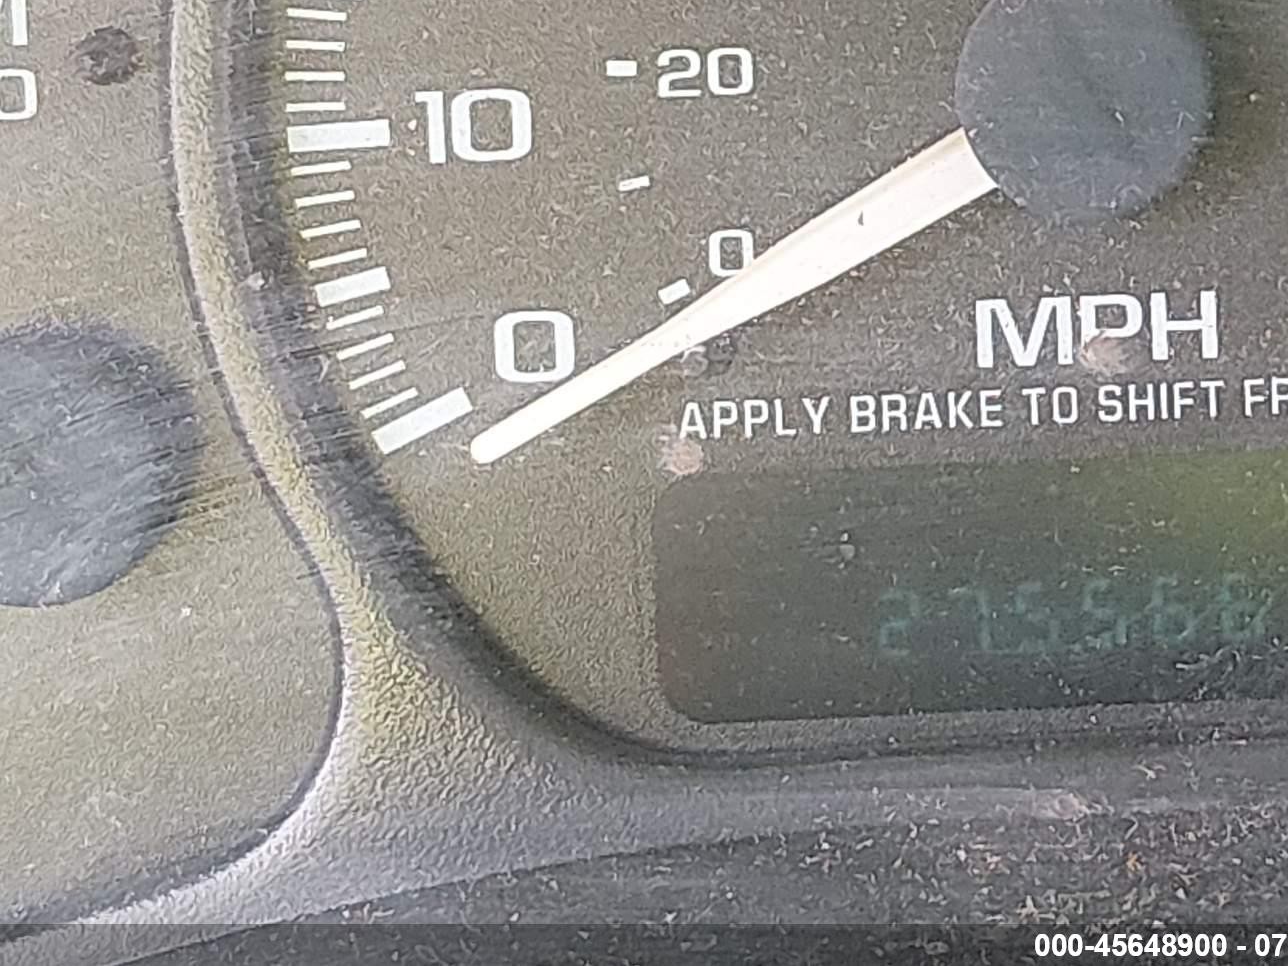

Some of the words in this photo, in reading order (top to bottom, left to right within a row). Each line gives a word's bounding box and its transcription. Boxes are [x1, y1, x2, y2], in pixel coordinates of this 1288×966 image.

[657, 47, 754, 98] 20
[414, 88, 532, 164] 10
[708, 229, 755, 278] 0
[493, 310, 577, 384] 0
[975, 290, 1218, 365] MPH
[678, 396, 830, 440] APPLY
[850, 389, 1003, 433] BRAKE
[1024, 386, 1078, 426] TO
[1098, 380, 1225, 422] SHIFT
